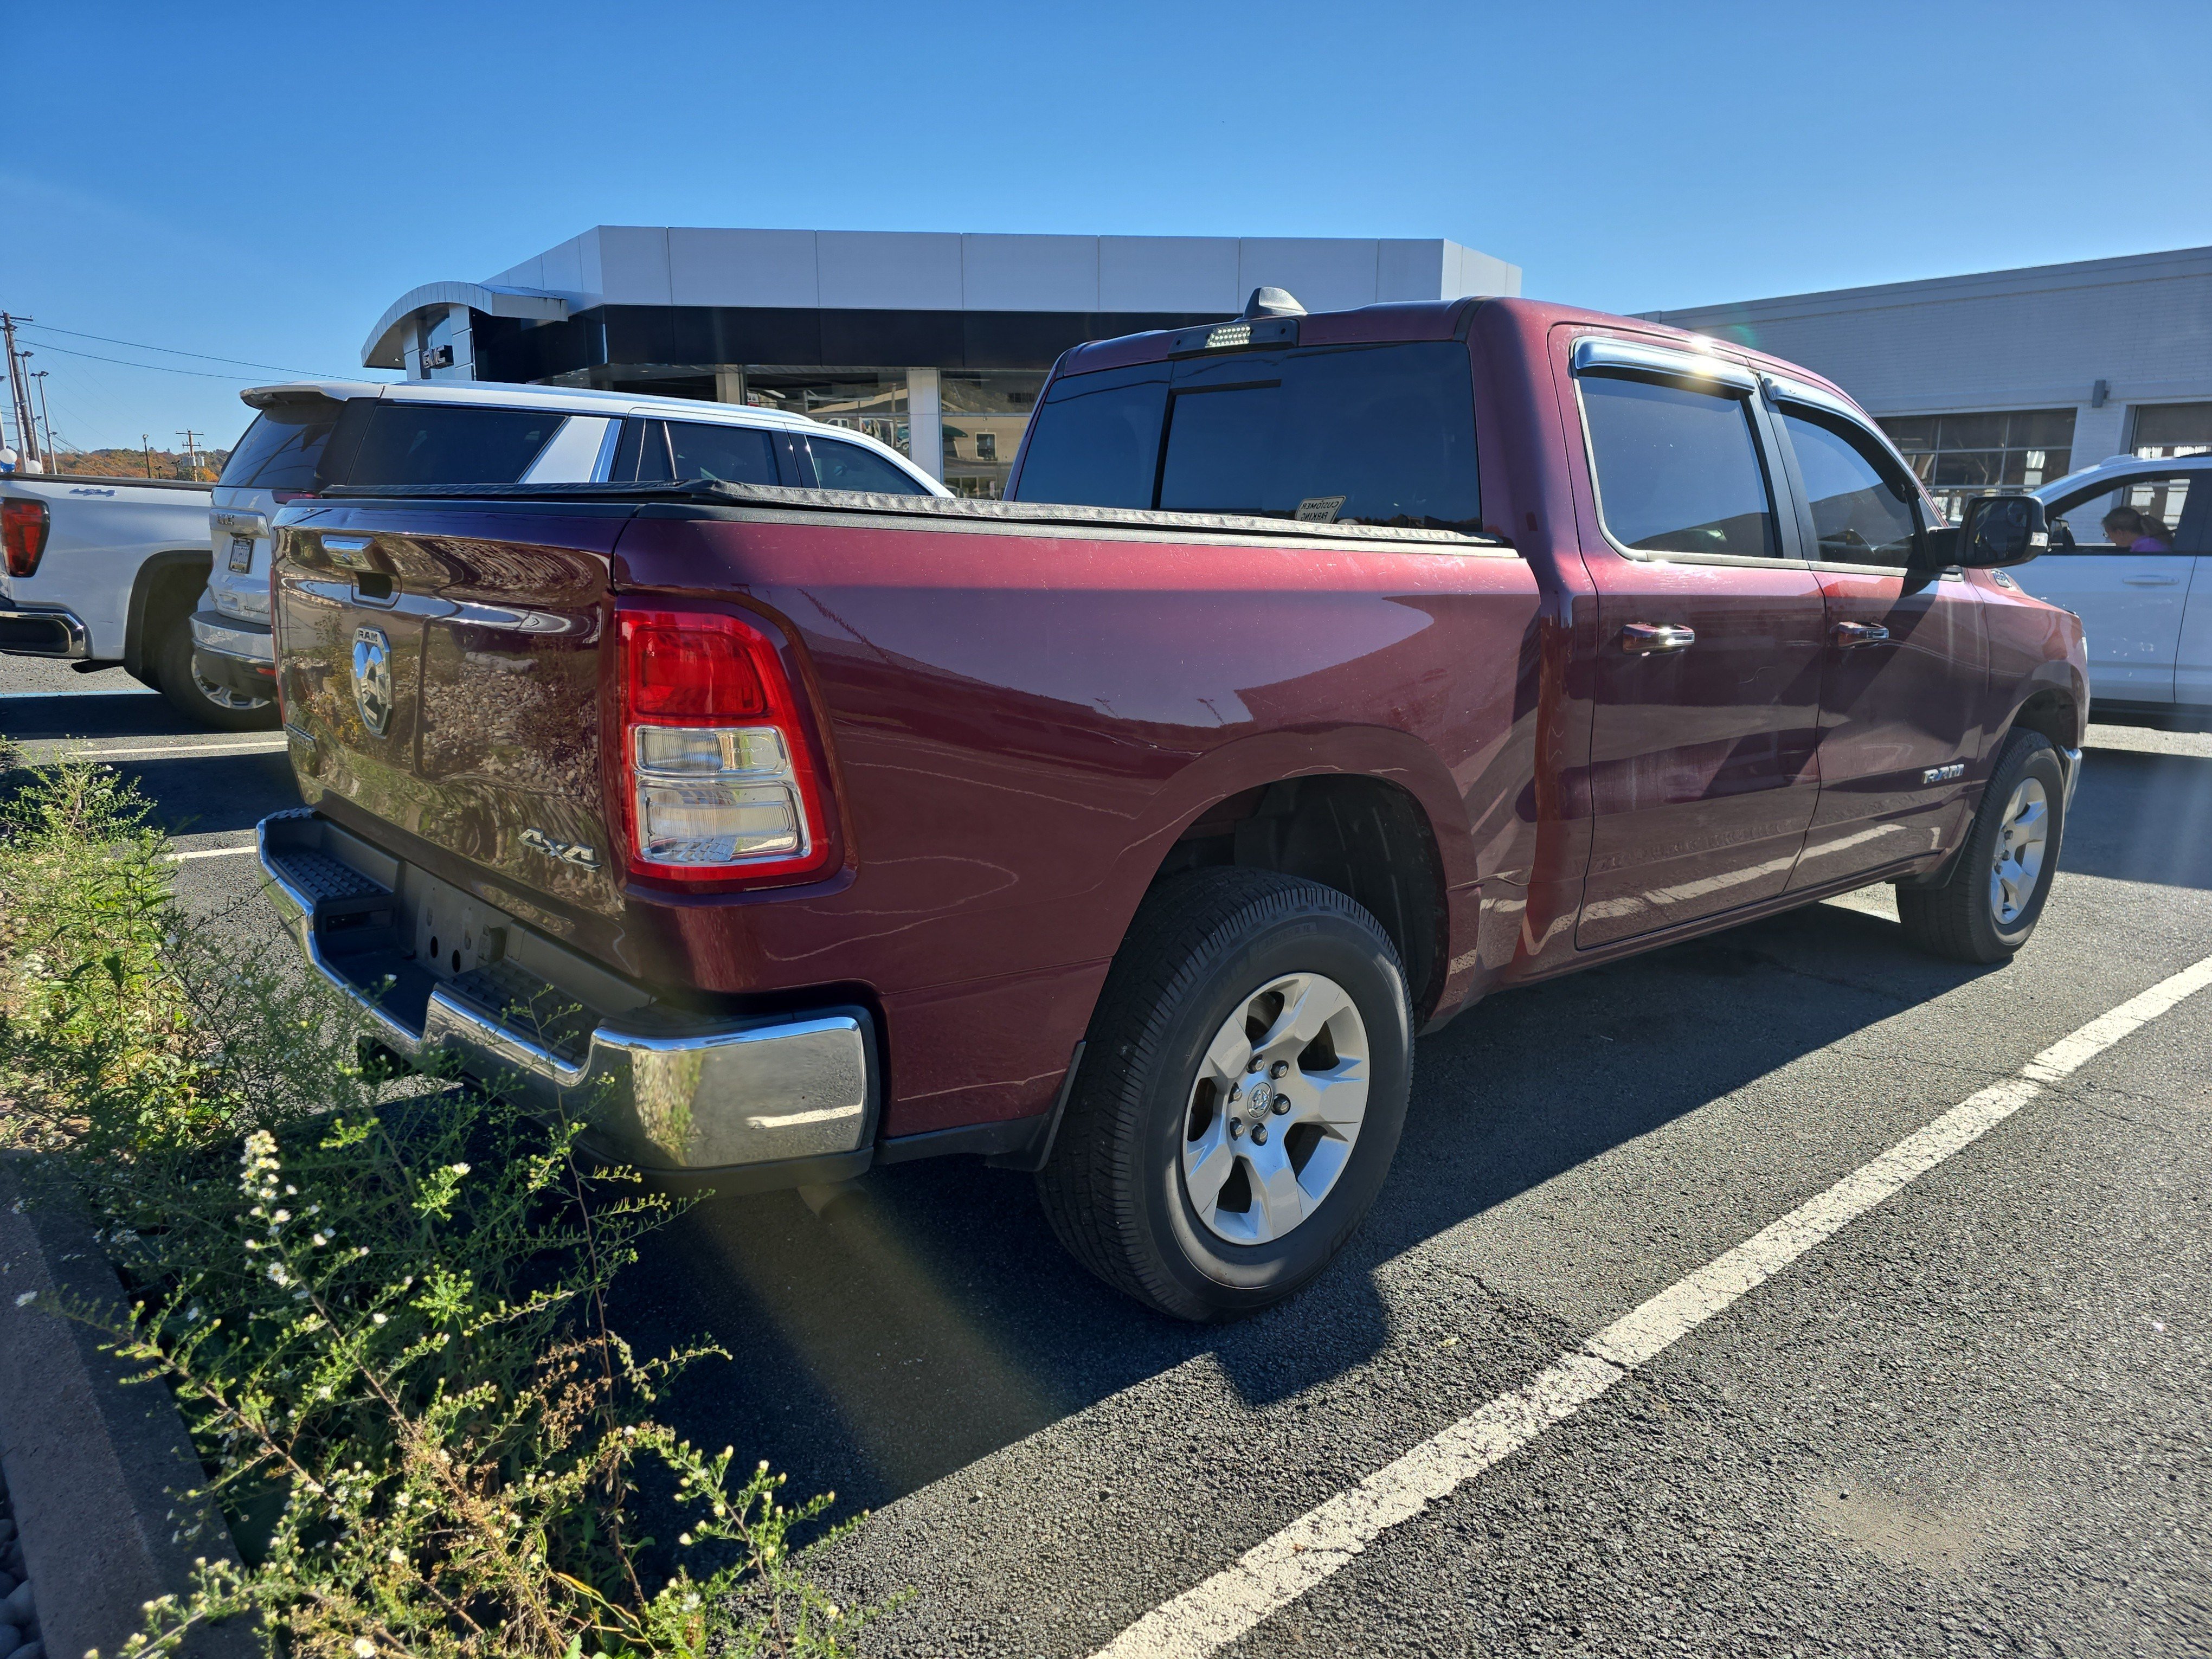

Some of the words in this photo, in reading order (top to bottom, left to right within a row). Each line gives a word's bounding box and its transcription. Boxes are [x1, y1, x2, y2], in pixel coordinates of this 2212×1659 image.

[422, 345, 447, 369] GMC
[217, 513, 234, 525] GMC
[358, 629, 378, 642] RAM
[1921, 764, 1964, 785] RAM
